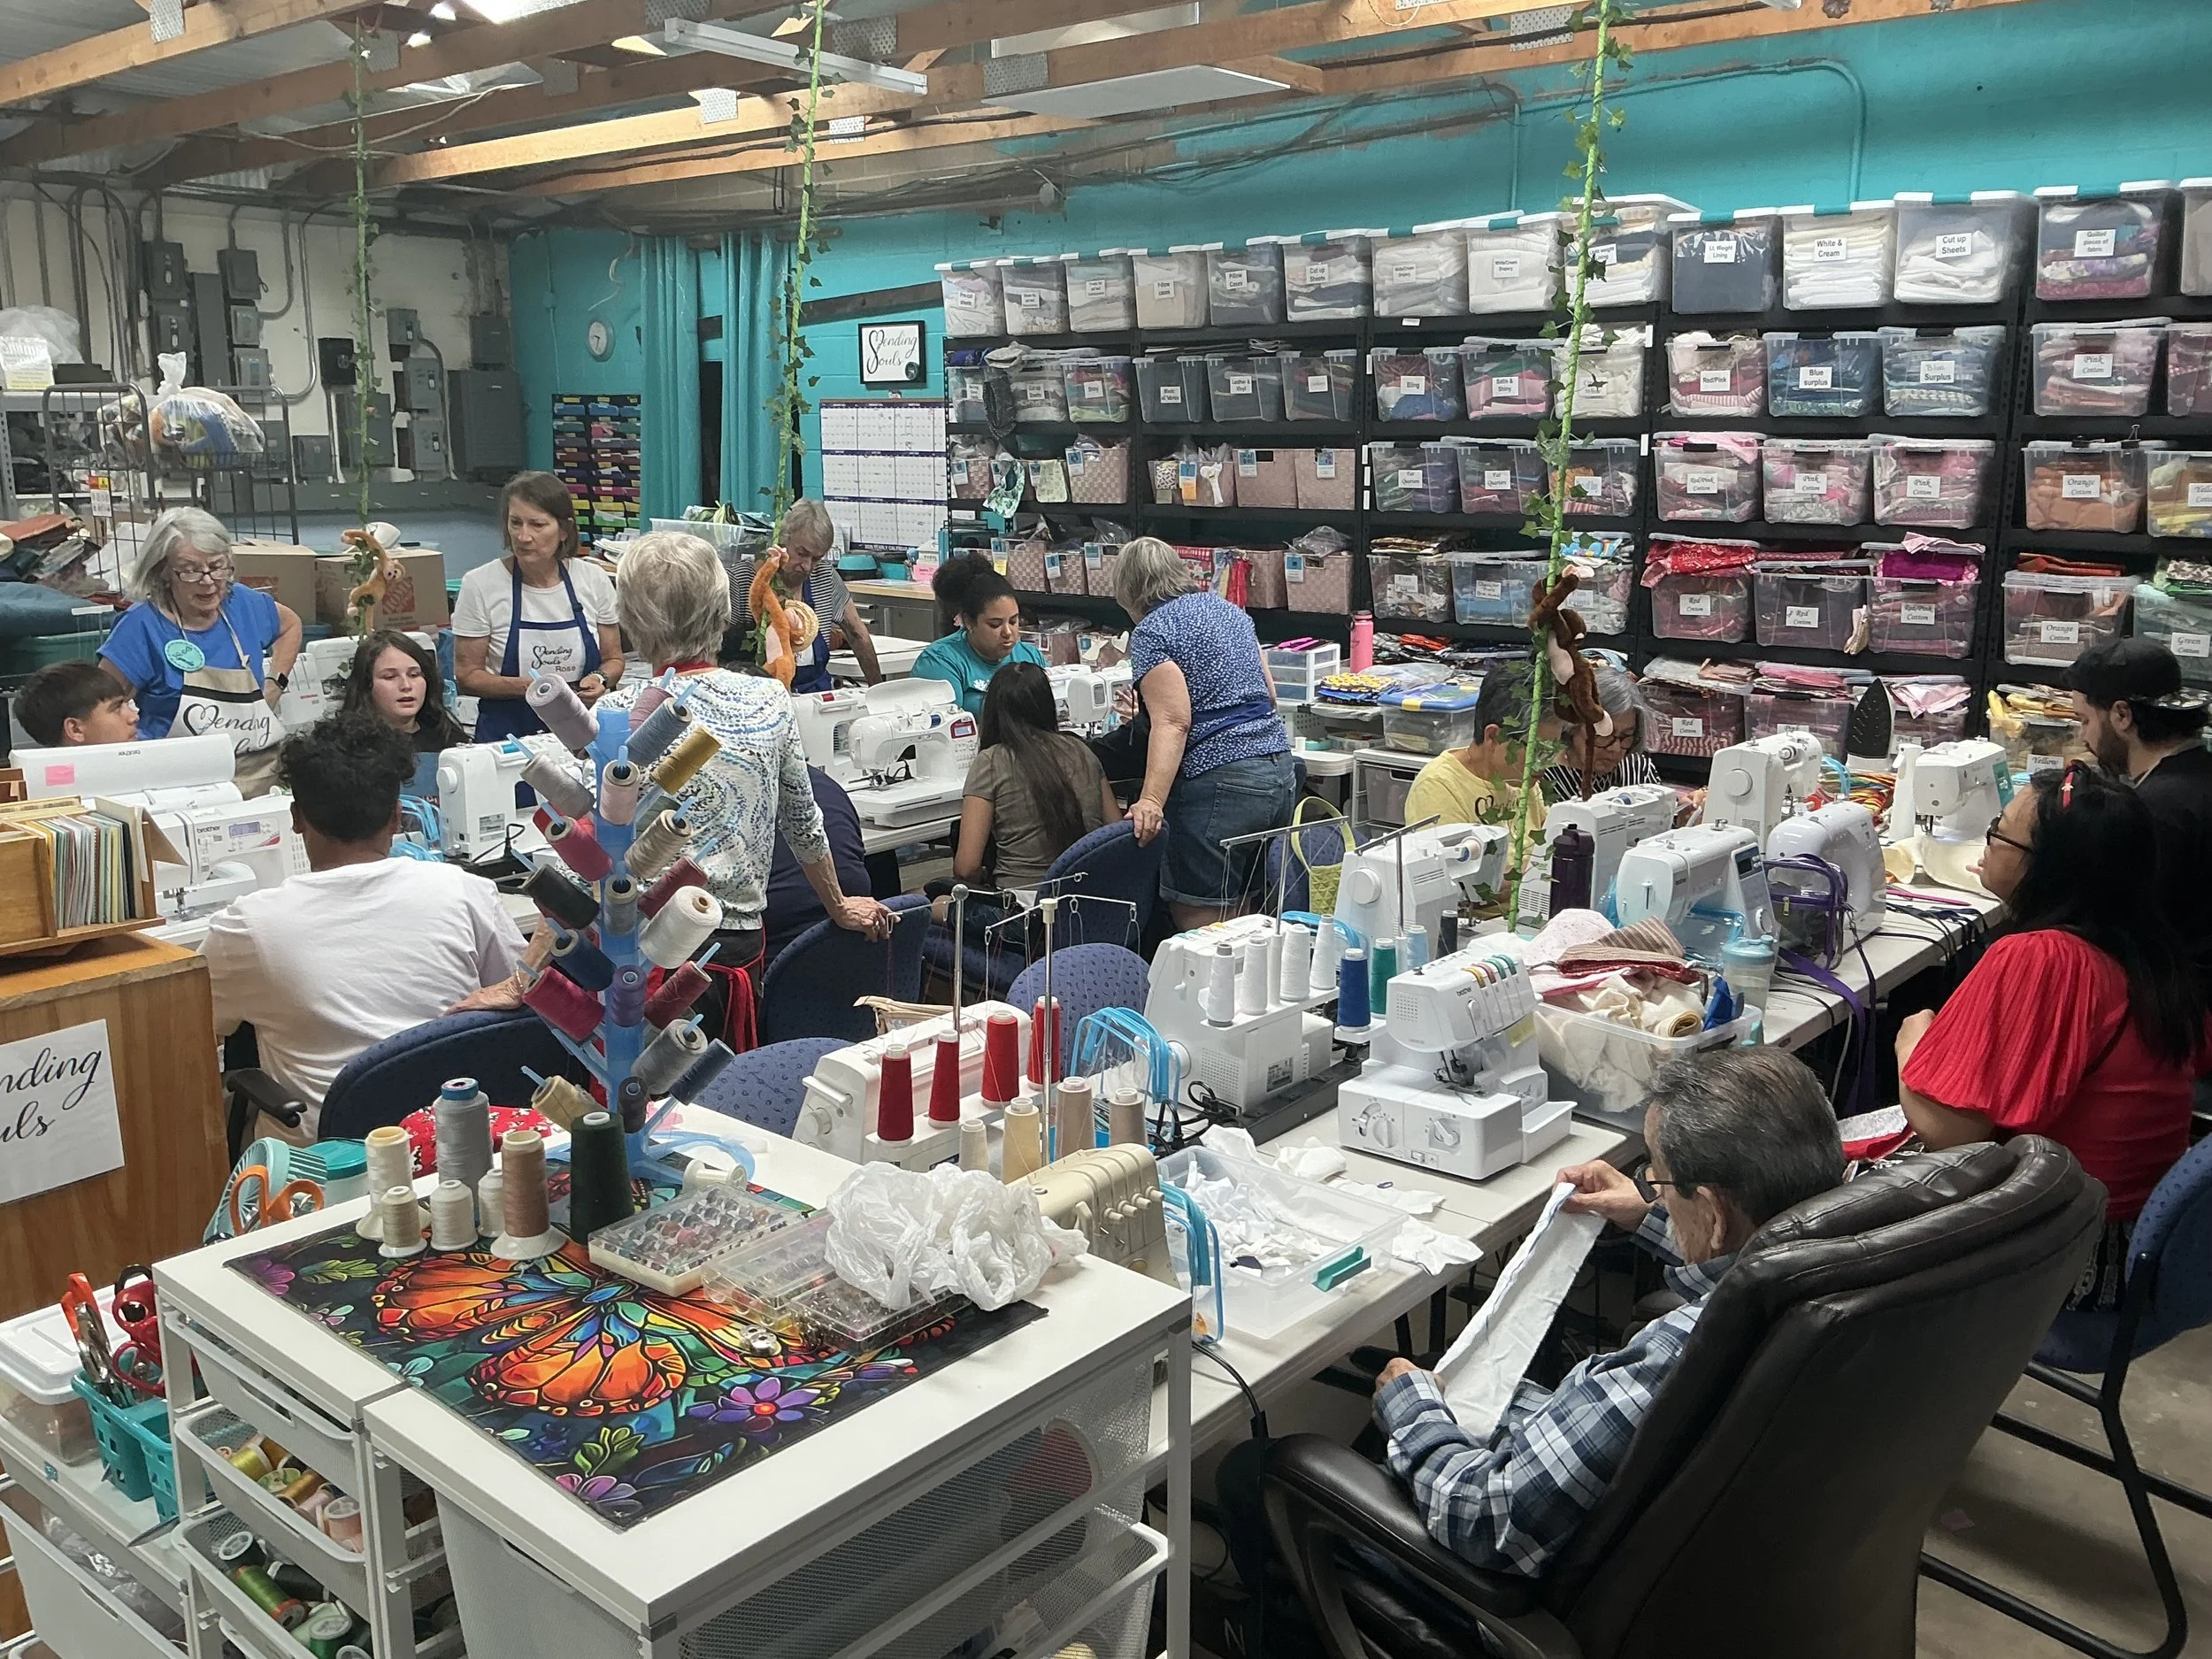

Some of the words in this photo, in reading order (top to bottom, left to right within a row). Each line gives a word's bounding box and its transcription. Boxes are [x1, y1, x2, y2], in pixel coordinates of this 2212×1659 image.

[1941, 245, 1966, 254] Sheets
[2083, 355, 2105, 364] Pink
[1406, 381, 1419, 390] Bling
[1914, 479, 1932, 488] Pink
[2068, 479, 2096, 488] Orange
[2046, 624, 2073, 634] Orange
[2177, 636, 2200, 645] Green
[533, 646, 572, 661] Mending
[2032, 757, 2059, 765] Yellow
